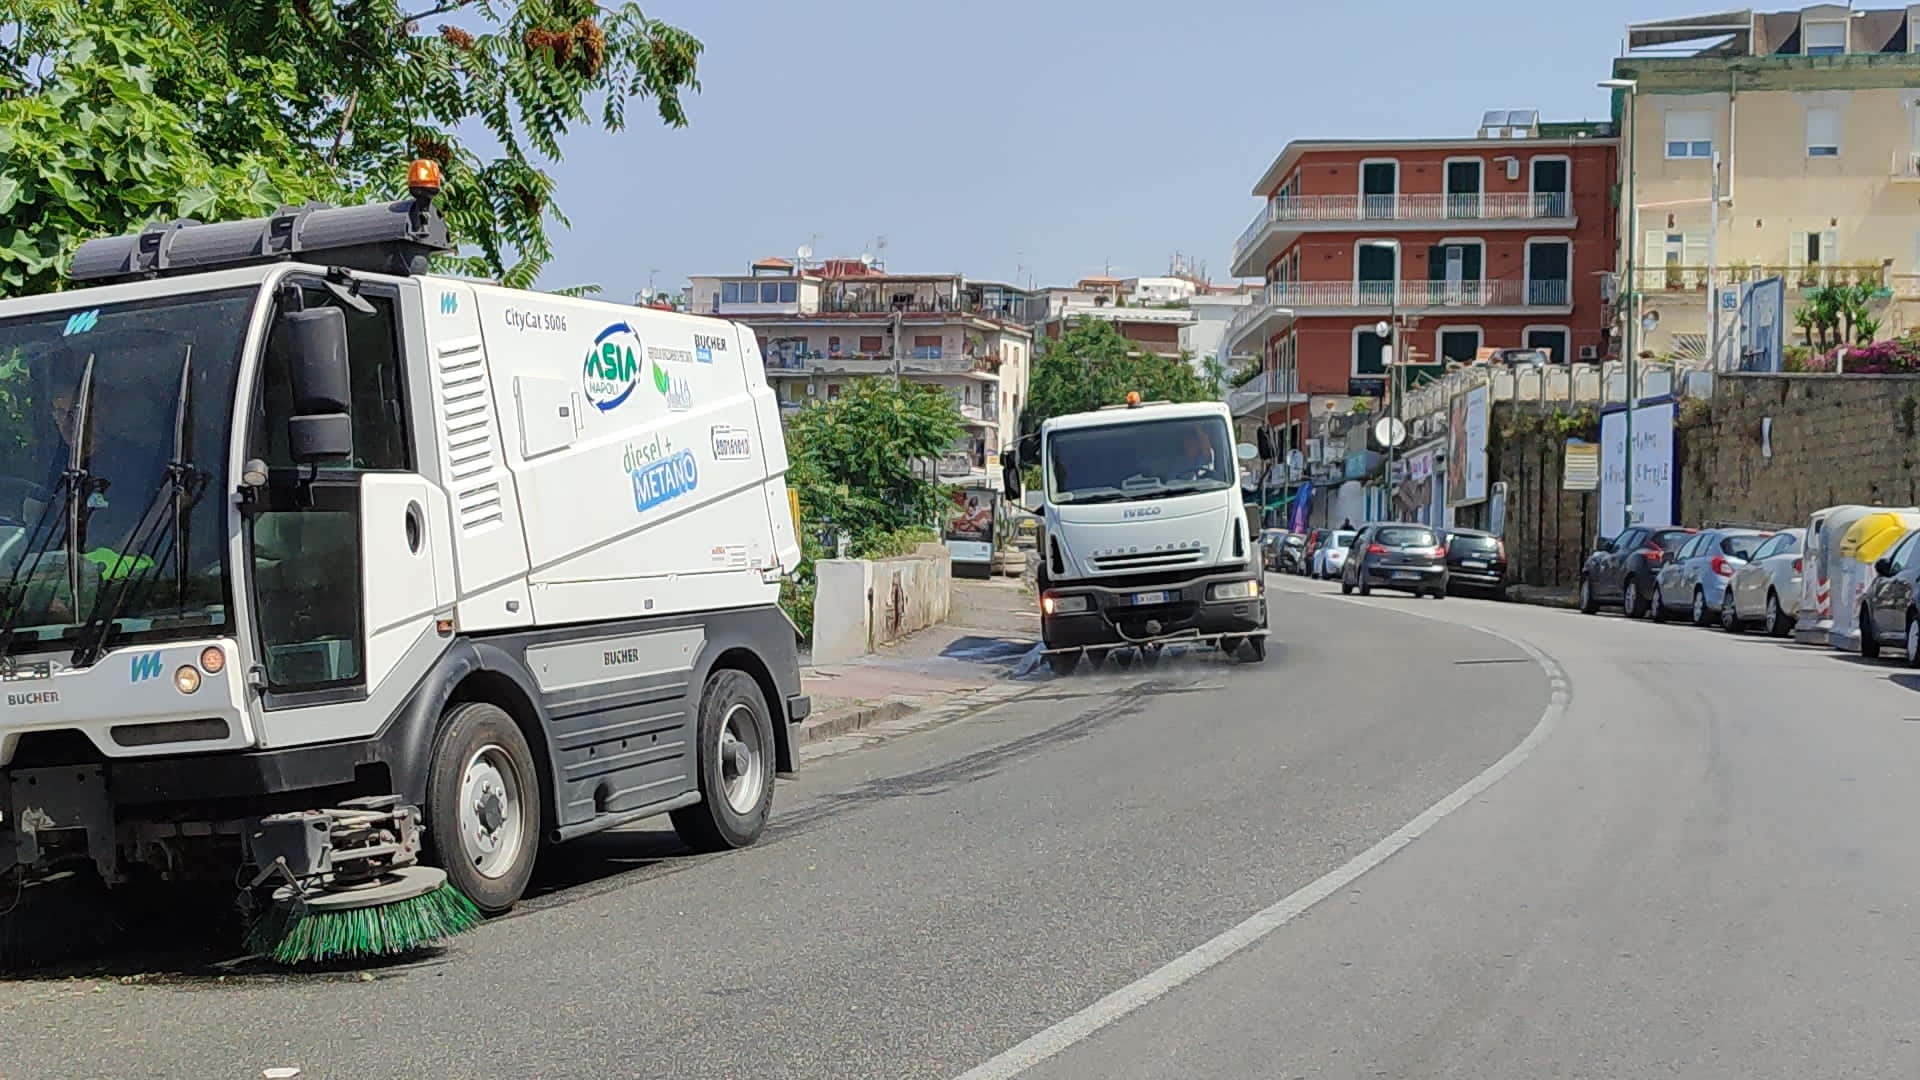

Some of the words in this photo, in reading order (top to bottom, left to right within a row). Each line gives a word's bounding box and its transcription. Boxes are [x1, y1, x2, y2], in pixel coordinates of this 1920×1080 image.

[505, 308, 542, 332] CityCat
[545, 314, 567, 331] 5006
[694, 334, 727, 351] BUCHER
[587, 342, 638, 382] ASIA
[589, 382, 620, 395] NAPOLI
[624, 432, 662, 474] diesel
[635, 454, 696, 505] METANO
[1123, 507, 1161, 519] IVECO
[604, 648, 639, 665] BUCHER
[8, 692, 60, 706] BUCHER
